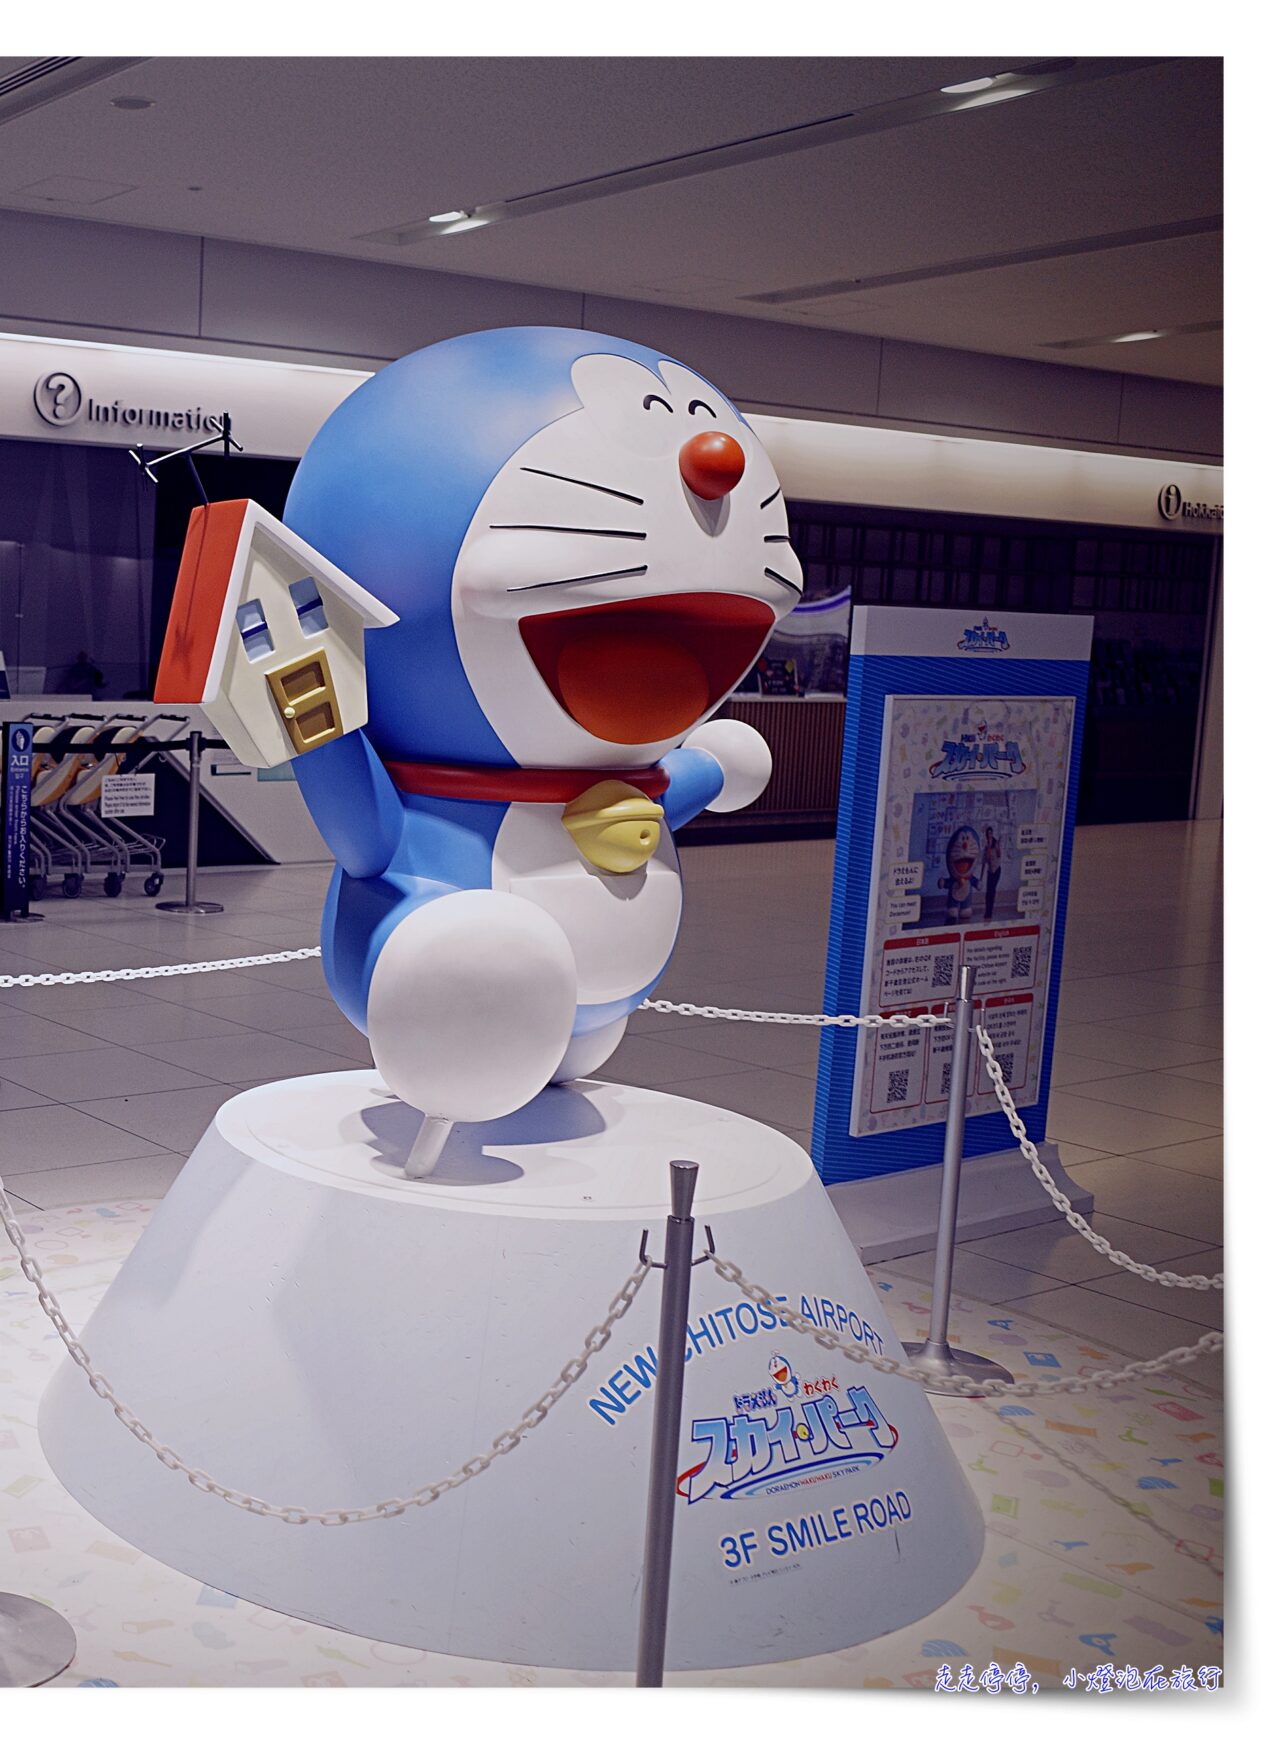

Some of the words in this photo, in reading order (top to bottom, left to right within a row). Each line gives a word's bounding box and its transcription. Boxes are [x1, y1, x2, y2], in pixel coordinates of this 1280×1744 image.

[11, 755, 29, 766] 入口
[589, 1346, 659, 1425] NEW
[801, 1295, 883, 1355] AIRPORT
[803, 1377, 839, 1395] わくわく
[720, 1532, 758, 1568] 3F
[768, 1508, 852, 1557] SMILE
[854, 1490, 912, 1534] ROAD
